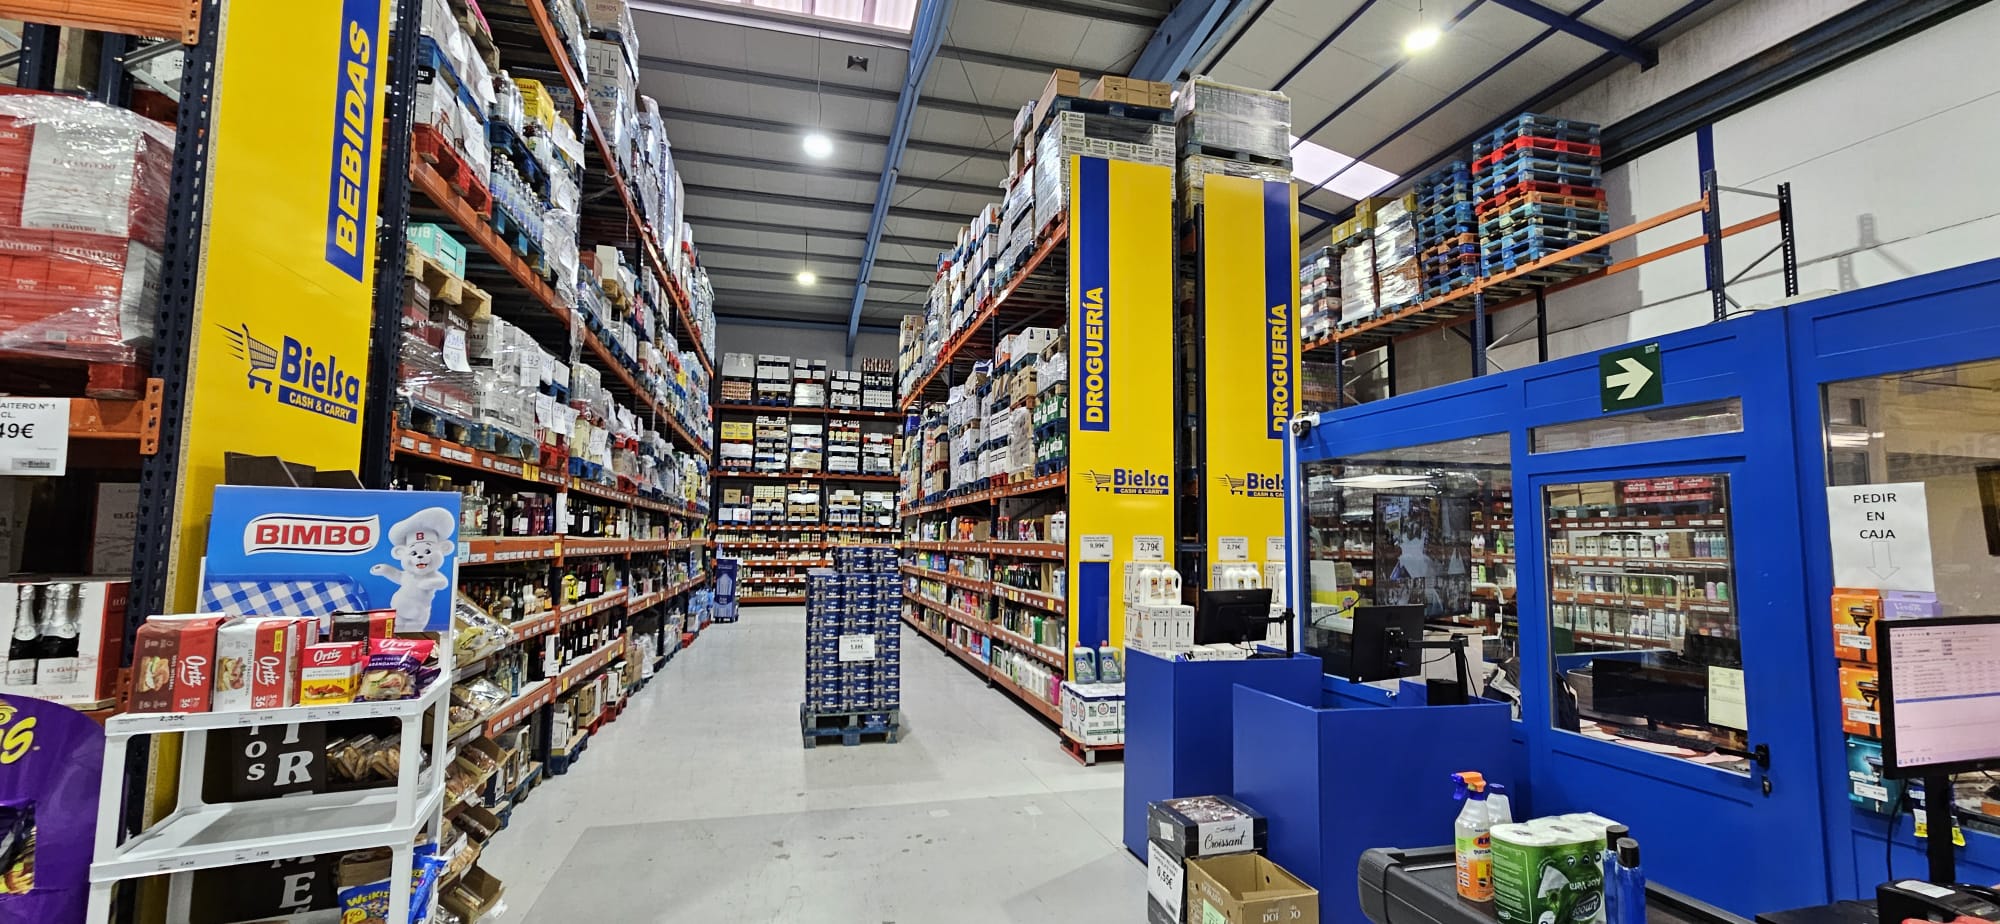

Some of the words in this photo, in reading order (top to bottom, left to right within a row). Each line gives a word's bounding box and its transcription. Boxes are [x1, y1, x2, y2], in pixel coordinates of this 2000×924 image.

[336, 20, 370, 257] BEBIDAS
[1083, 287, 1104, 423] DROGUERÍA
[280, 335, 360, 405] Bielsa
[1267, 303, 1288, 432] DROGUERÍA
[289, 391, 314, 409] CASH
[315, 400, 323, 412] &
[324, 402, 351, 420] CARRY
[1113, 468, 1169, 487] Bielsa
[1854, 492, 1897, 504] PEDIR
[1866, 511, 1885, 521] EN
[255, 524, 372, 546] BIMBO
[415, 532, 425, 541] B
[1859, 529, 1896, 540] CAJA
[1140, 542, 1160, 552] 2,79€
[313, 648, 343, 666] Ortiz
[179, 655, 207, 688] Ortiz
[253, 655, 280, 687] Ortiz
[255, 695, 266, 708] 36
[160, 714, 185, 722] 2,35€
[1204, 829, 1247, 850] Croissant
[1569, 880, 1587, 891] Vera
